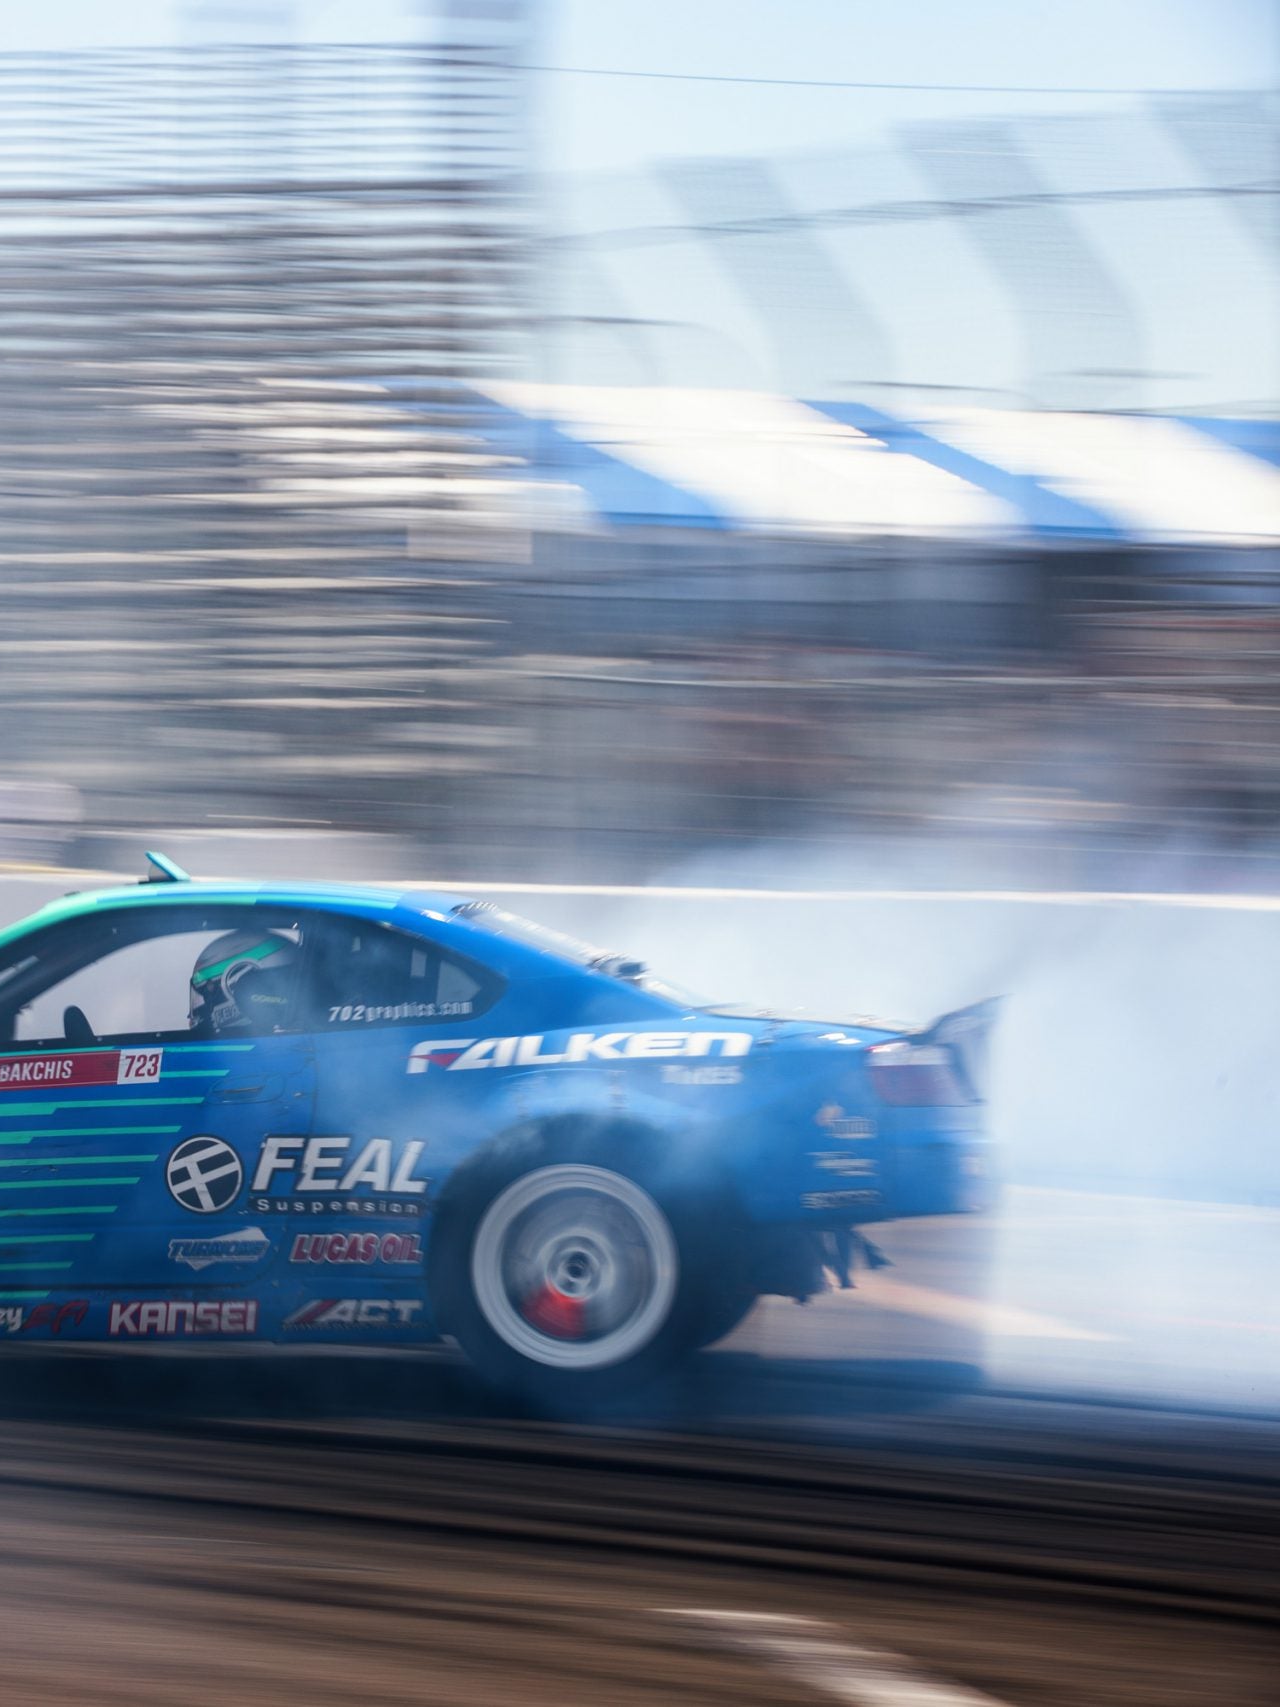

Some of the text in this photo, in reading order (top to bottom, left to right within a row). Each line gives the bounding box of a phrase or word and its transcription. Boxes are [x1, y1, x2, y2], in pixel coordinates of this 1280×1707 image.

[328, 1002, 473, 1022] 702graphics.com
[123, 1053, 160, 1079] 723
[406, 1032, 752, 1074] FALKEN
[251, 1137, 429, 1193] FEAL
[257, 1199, 420, 1216] Suspension
[290, 1232, 424, 1264] LUCAS OIL
[109, 1301, 258, 1334] KANSEI
[320, 1299, 424, 1323] ACT
